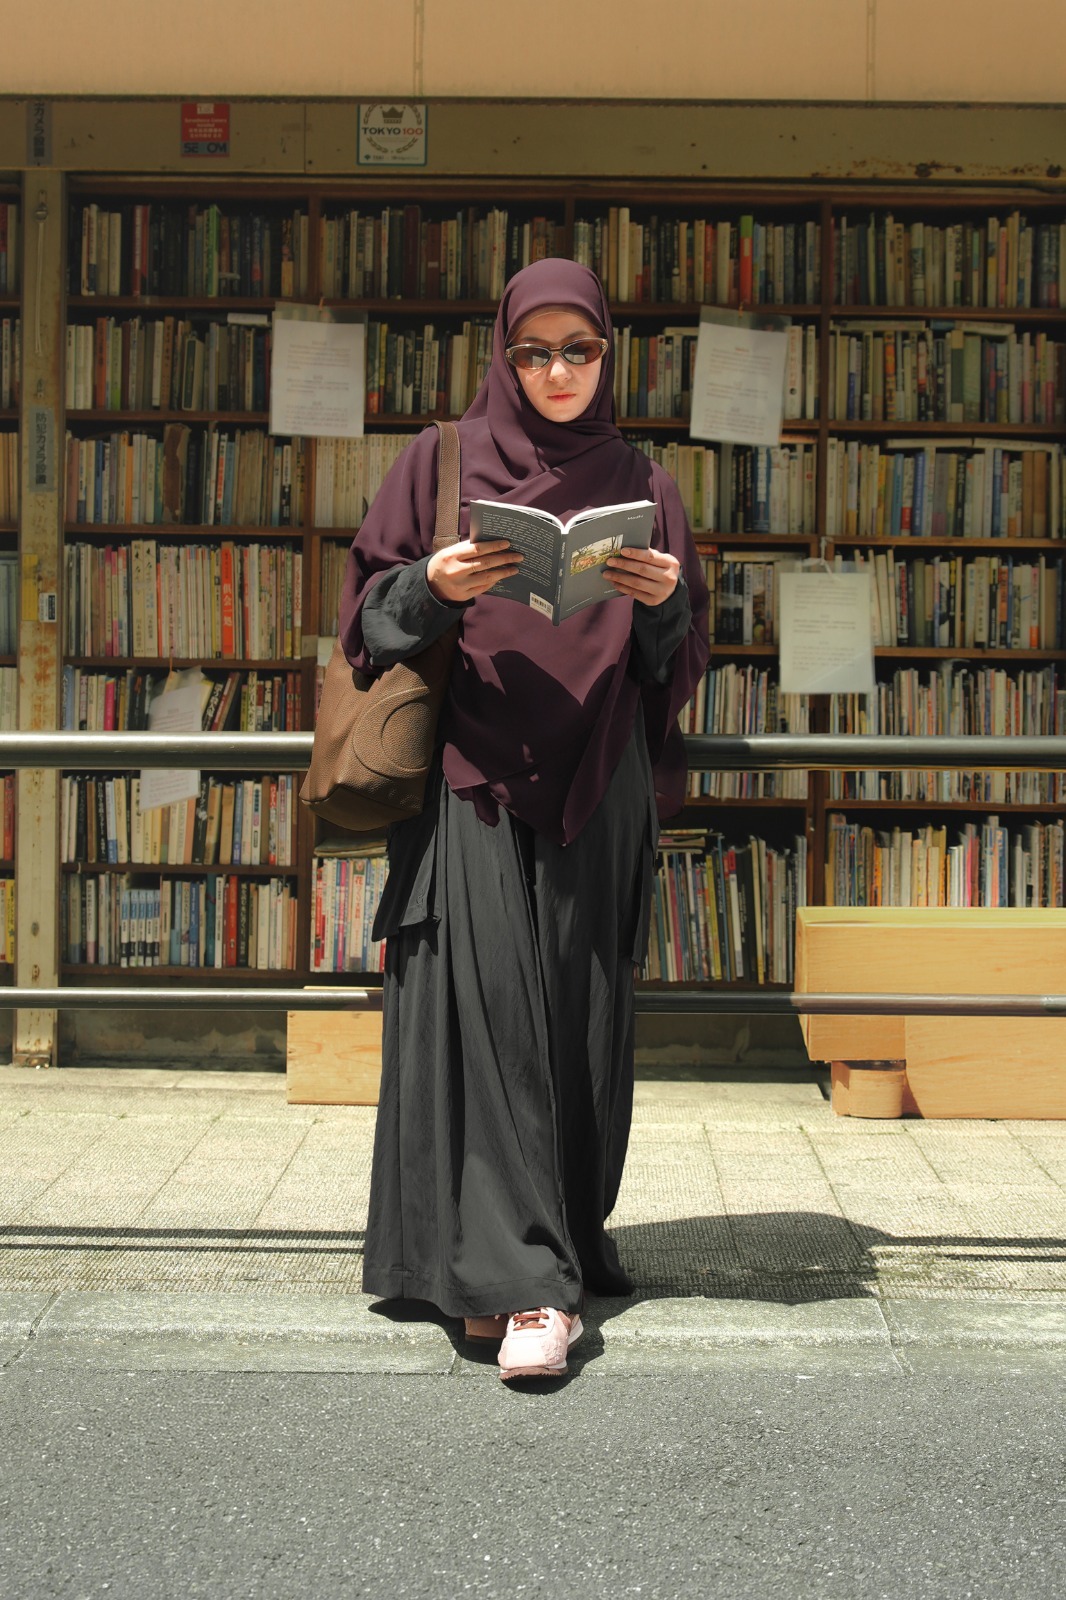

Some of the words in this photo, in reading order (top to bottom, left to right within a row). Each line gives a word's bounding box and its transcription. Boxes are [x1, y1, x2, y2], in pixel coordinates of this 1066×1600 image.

[361, 127, 401, 135] TOKYO
[402, 127, 424, 135] 100
[35, 412, 47, 484] 防犯カメラ設置
